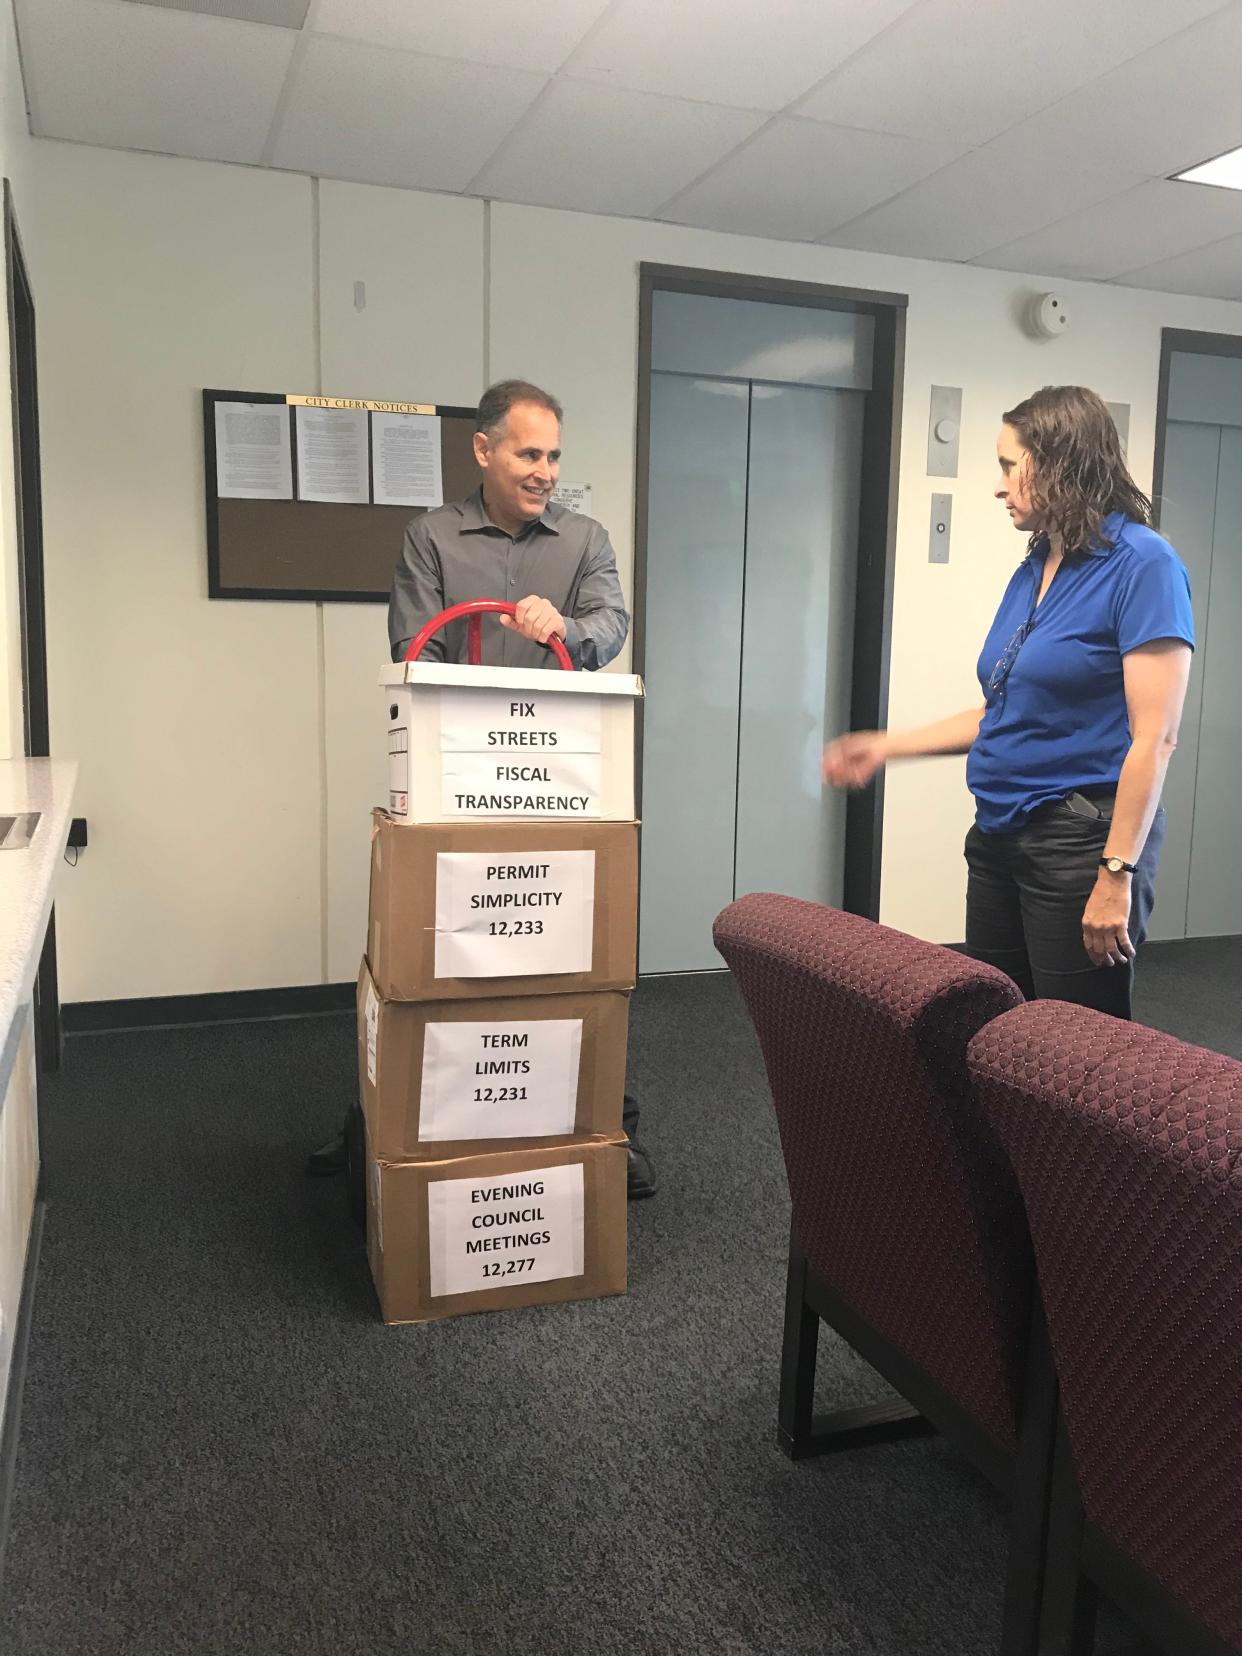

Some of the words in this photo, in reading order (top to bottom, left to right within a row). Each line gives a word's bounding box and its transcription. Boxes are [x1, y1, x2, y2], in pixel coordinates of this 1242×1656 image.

[306, 397, 330, 406] CITY
[335, 399, 369, 409] CLERK
[373, 402, 418, 412] NOTICES
[510, 702, 536, 717] FIX
[487, 731, 558, 746] STREETS
[496, 766, 552, 782] FISCAL
[454, 794, 590, 811] TRANSPARENCY
[486, 864, 551, 880] PERMIT
[470, 892, 563, 909] SIMPLICITY
[488, 920, 544, 938] 12,233
[480, 1033, 529, 1049] TERM
[475, 1060, 531, 1075] LIMITS
[473, 1087, 528, 1104] 12,231
[471, 1181, 545, 1203] EVENING
[471, 1207, 545, 1229] COUNCIL
[465, 1230, 551, 1254] MEETINGS
[481, 1257, 536, 1278] 12,277
